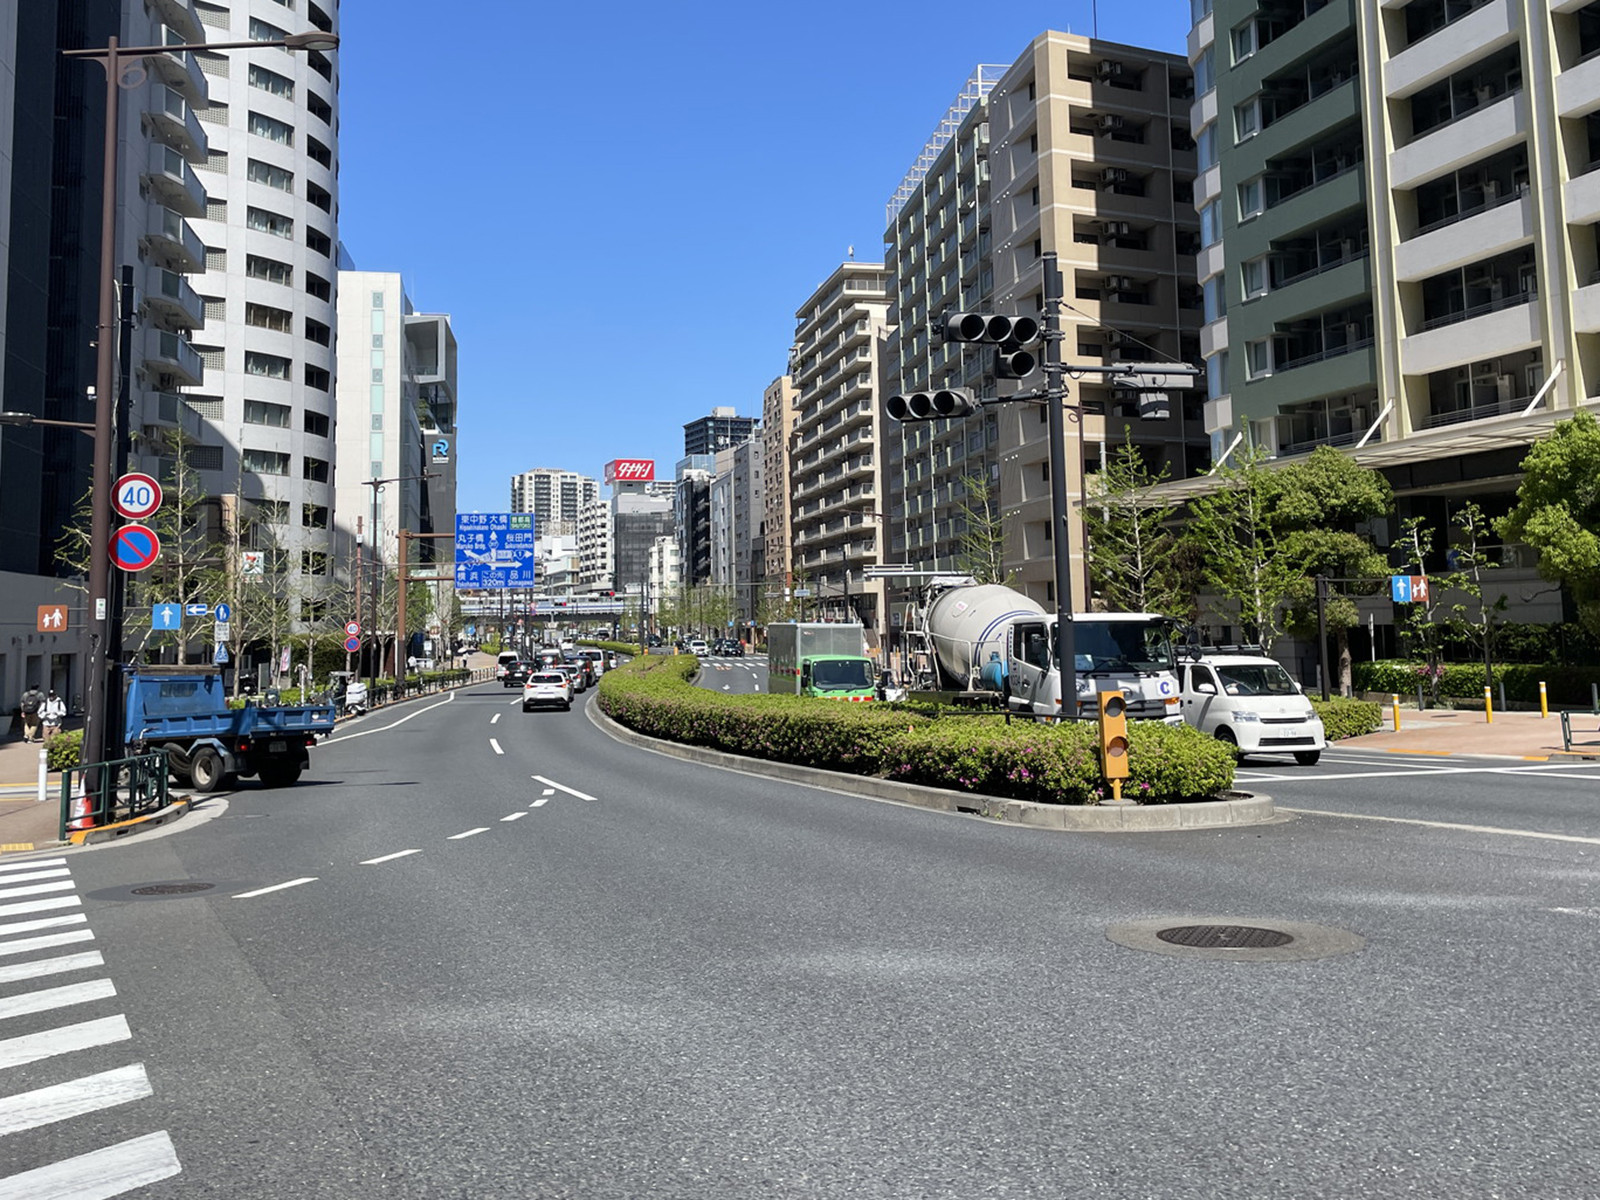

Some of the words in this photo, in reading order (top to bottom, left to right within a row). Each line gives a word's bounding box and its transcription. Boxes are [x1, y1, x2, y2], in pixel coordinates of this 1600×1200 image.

[122, 486, 150, 506] 40
[461, 515, 487, 524] 東中野
[489, 515, 507, 524] 大橋
[458, 533, 484, 543] 丸子橋
[506, 533, 532, 542] 桜田門
[457, 571, 478, 580] 横浜
[510, 570, 531, 580] 品川
[482, 579, 505, 587] 320m
[1160, 681, 1170, 695] C
